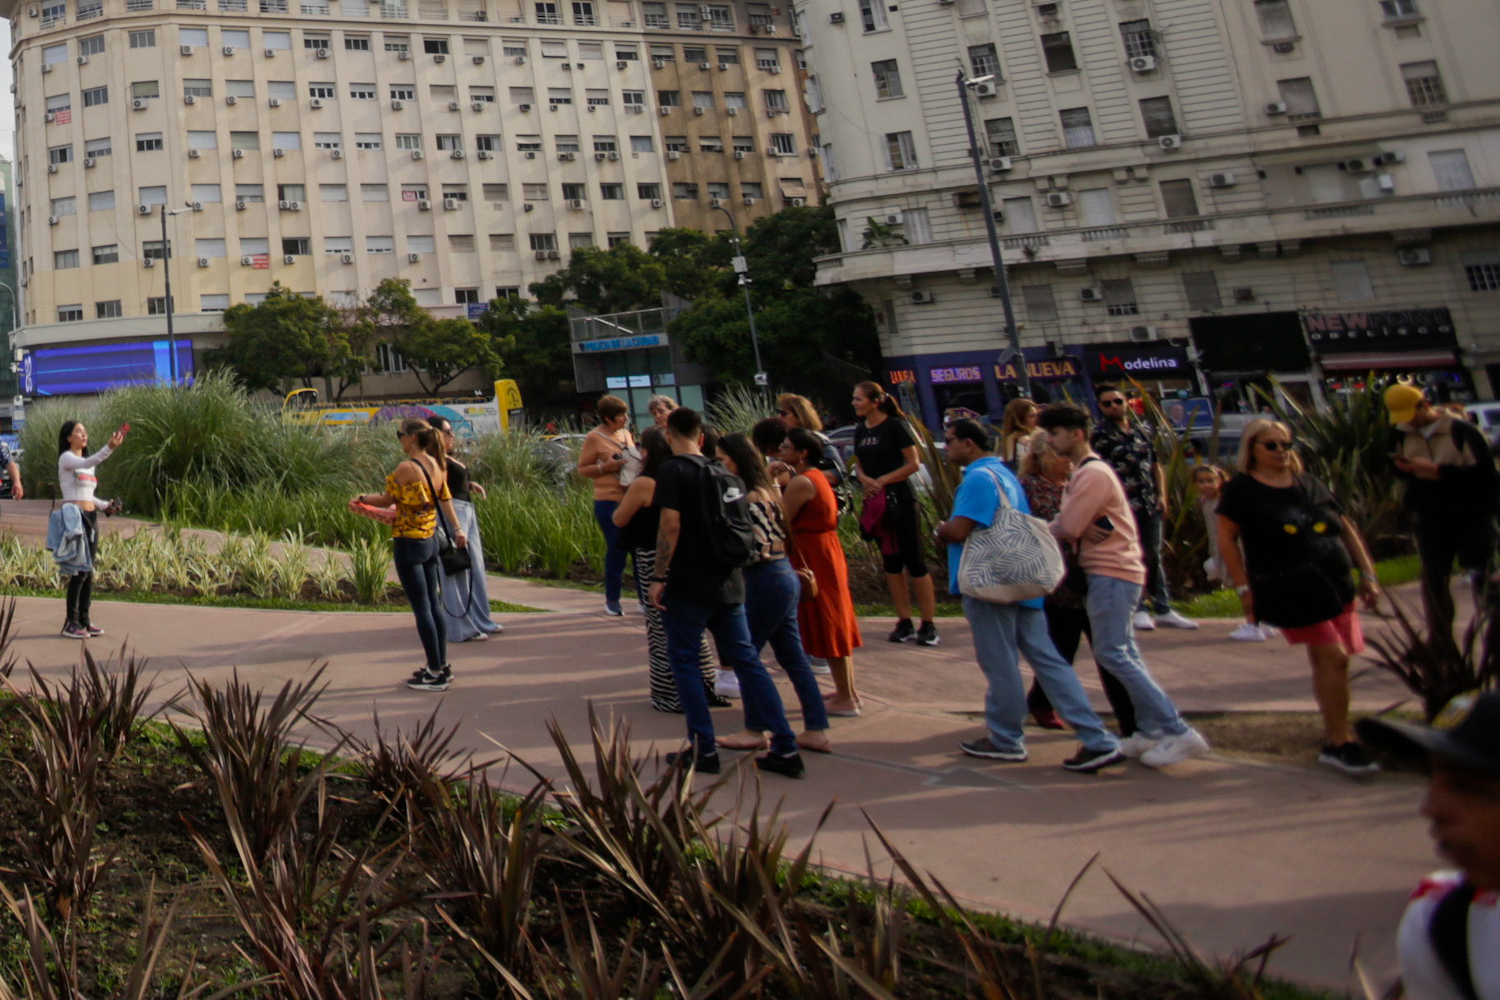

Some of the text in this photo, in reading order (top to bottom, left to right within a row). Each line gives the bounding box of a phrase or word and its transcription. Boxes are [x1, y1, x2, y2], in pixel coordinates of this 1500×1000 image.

[1099, 352, 1178, 372] Modelina
[930, 366, 981, 383] SEGUROS
[994, 364, 1018, 380] LA
